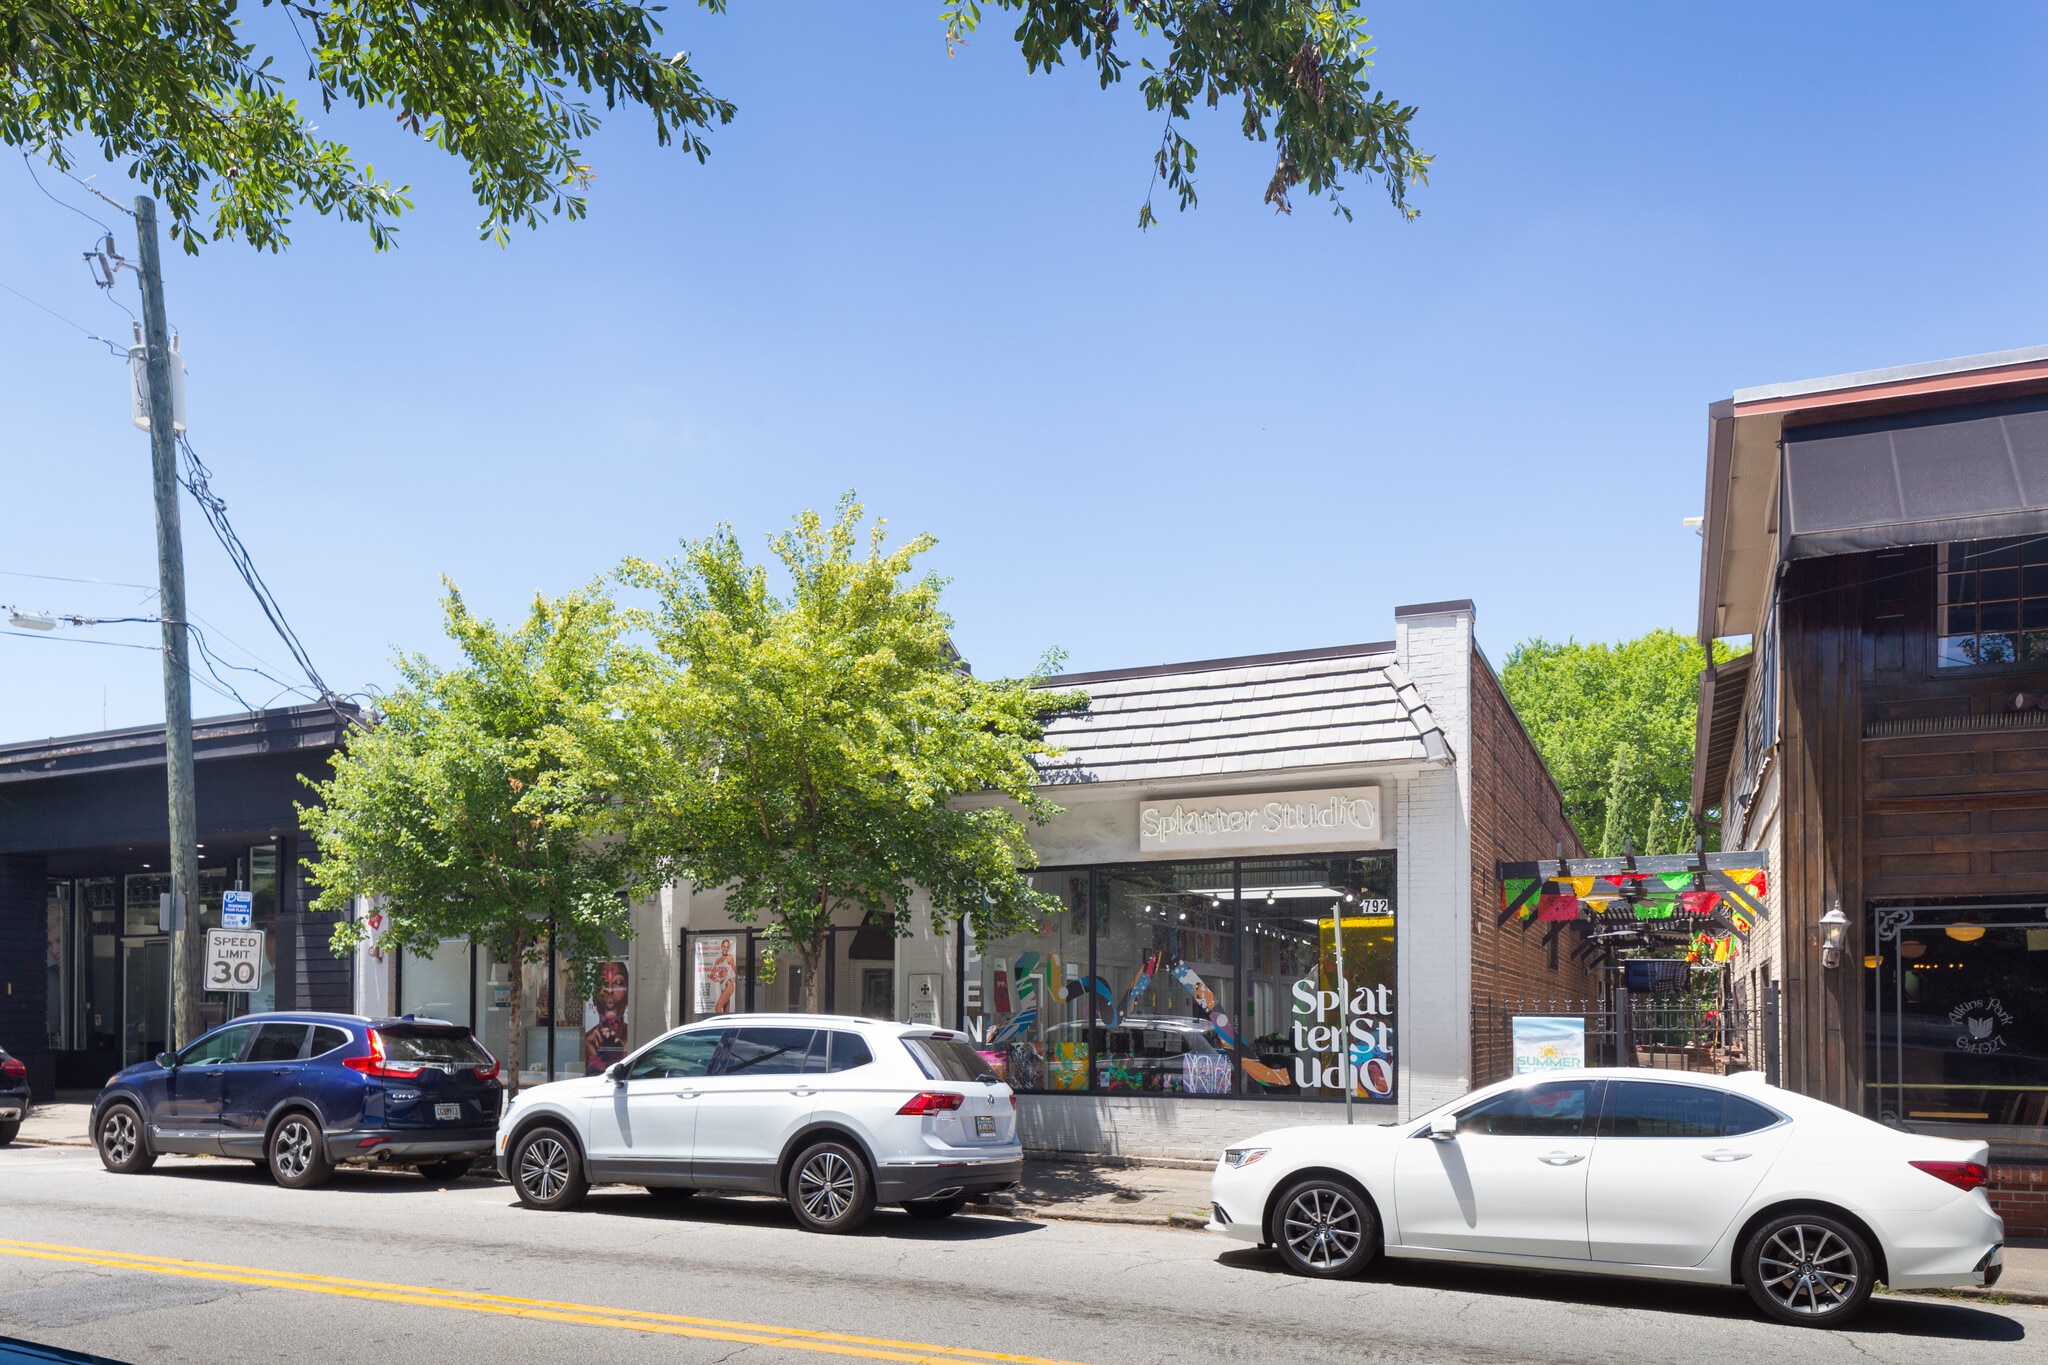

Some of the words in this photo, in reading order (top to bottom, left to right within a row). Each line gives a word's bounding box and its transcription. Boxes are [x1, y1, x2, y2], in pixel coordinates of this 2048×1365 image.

[1142, 805, 1259, 842] Splatter
[1364, 900, 1387, 913] 792
[213, 936, 257, 947] SPEED
[218, 949, 250, 959] LIMIT
[211, 961, 255, 984] 30
[1291, 978, 1393, 1023] Splat
[1985, 997, 2014, 1026] Park
[1517, 1055, 1581, 1068] SUMMER
